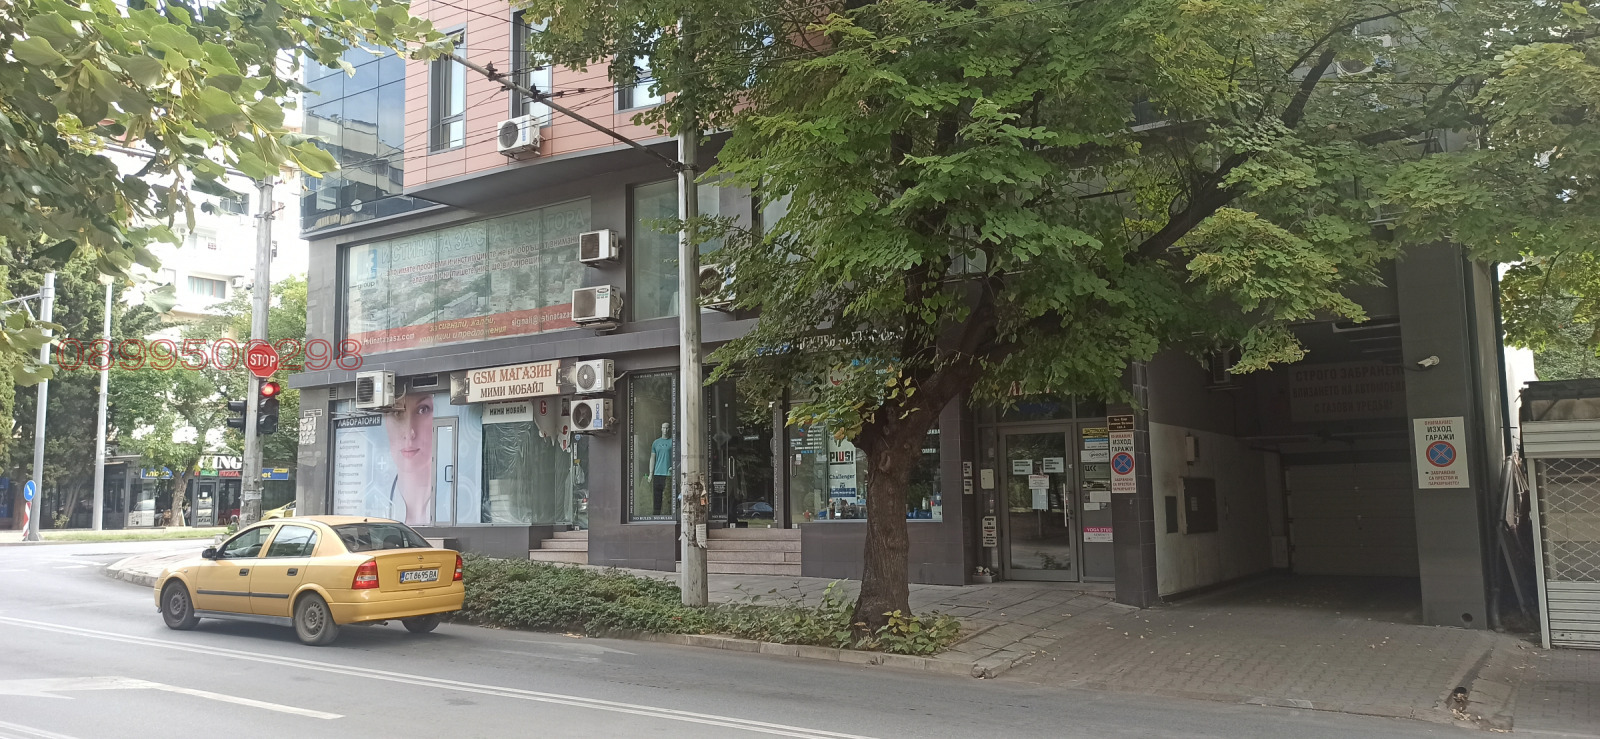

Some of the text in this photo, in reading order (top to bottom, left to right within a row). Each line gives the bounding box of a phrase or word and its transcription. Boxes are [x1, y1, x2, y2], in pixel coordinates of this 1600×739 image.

[381, 209, 584, 264] ИСТИНАТА ЗА СТАРА ЗАГОРА
[550, 235, 581, 249] внимани
[357, 281, 375, 290] goup
[250, 354, 276, 367] STOP
[473, 364, 552, 384] GSM МАГАЗИН
[1295, 369, 1337, 382] СТРОГО
[480, 382, 544, 398] МИМИ МОБАЙЛ
[1293, 386, 1339, 398] ВЛИЗАНЕТО
[1341, 385, 1352, 396] НА
[1314, 402, 1320, 414] С
[1322, 401, 1353, 413] ГАЗОВИ
[337, 416, 381, 427] ЛАБОРАТОРИЯ
[1427, 425, 1452, 433] ИЗХОД
[829, 451, 854, 462] PIUSI
[829, 473, 855, 481] Challenger
